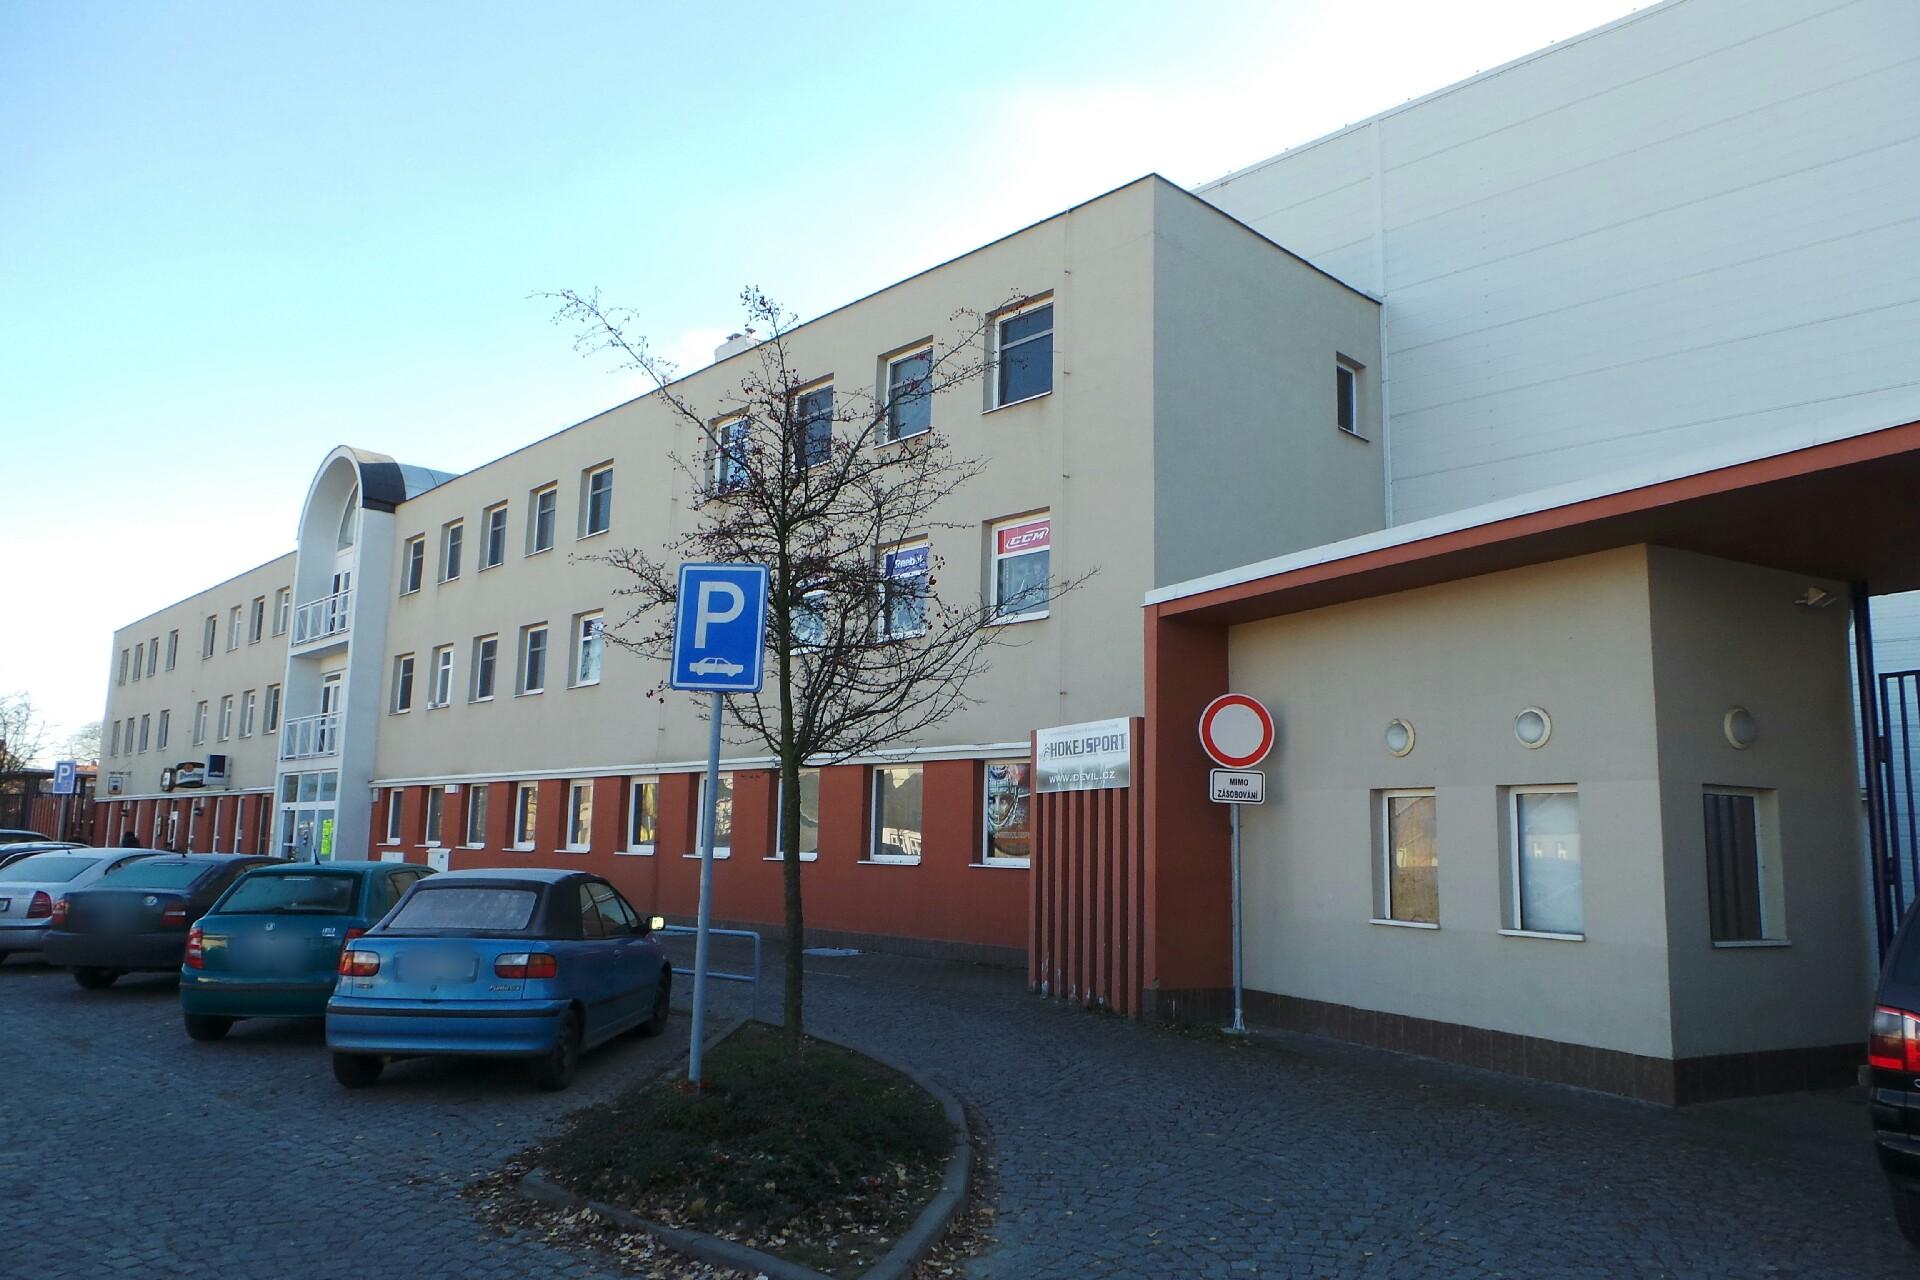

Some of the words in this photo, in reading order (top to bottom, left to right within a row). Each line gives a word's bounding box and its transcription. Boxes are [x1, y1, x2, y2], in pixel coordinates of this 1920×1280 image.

[1009, 530, 1046, 546] CCM
[694, 581, 745, 648] P
[1050, 733, 1127, 757] HOKEJSPORT
[58, 765, 71, 783] P
[1229, 777, 1249, 786] MIMO
